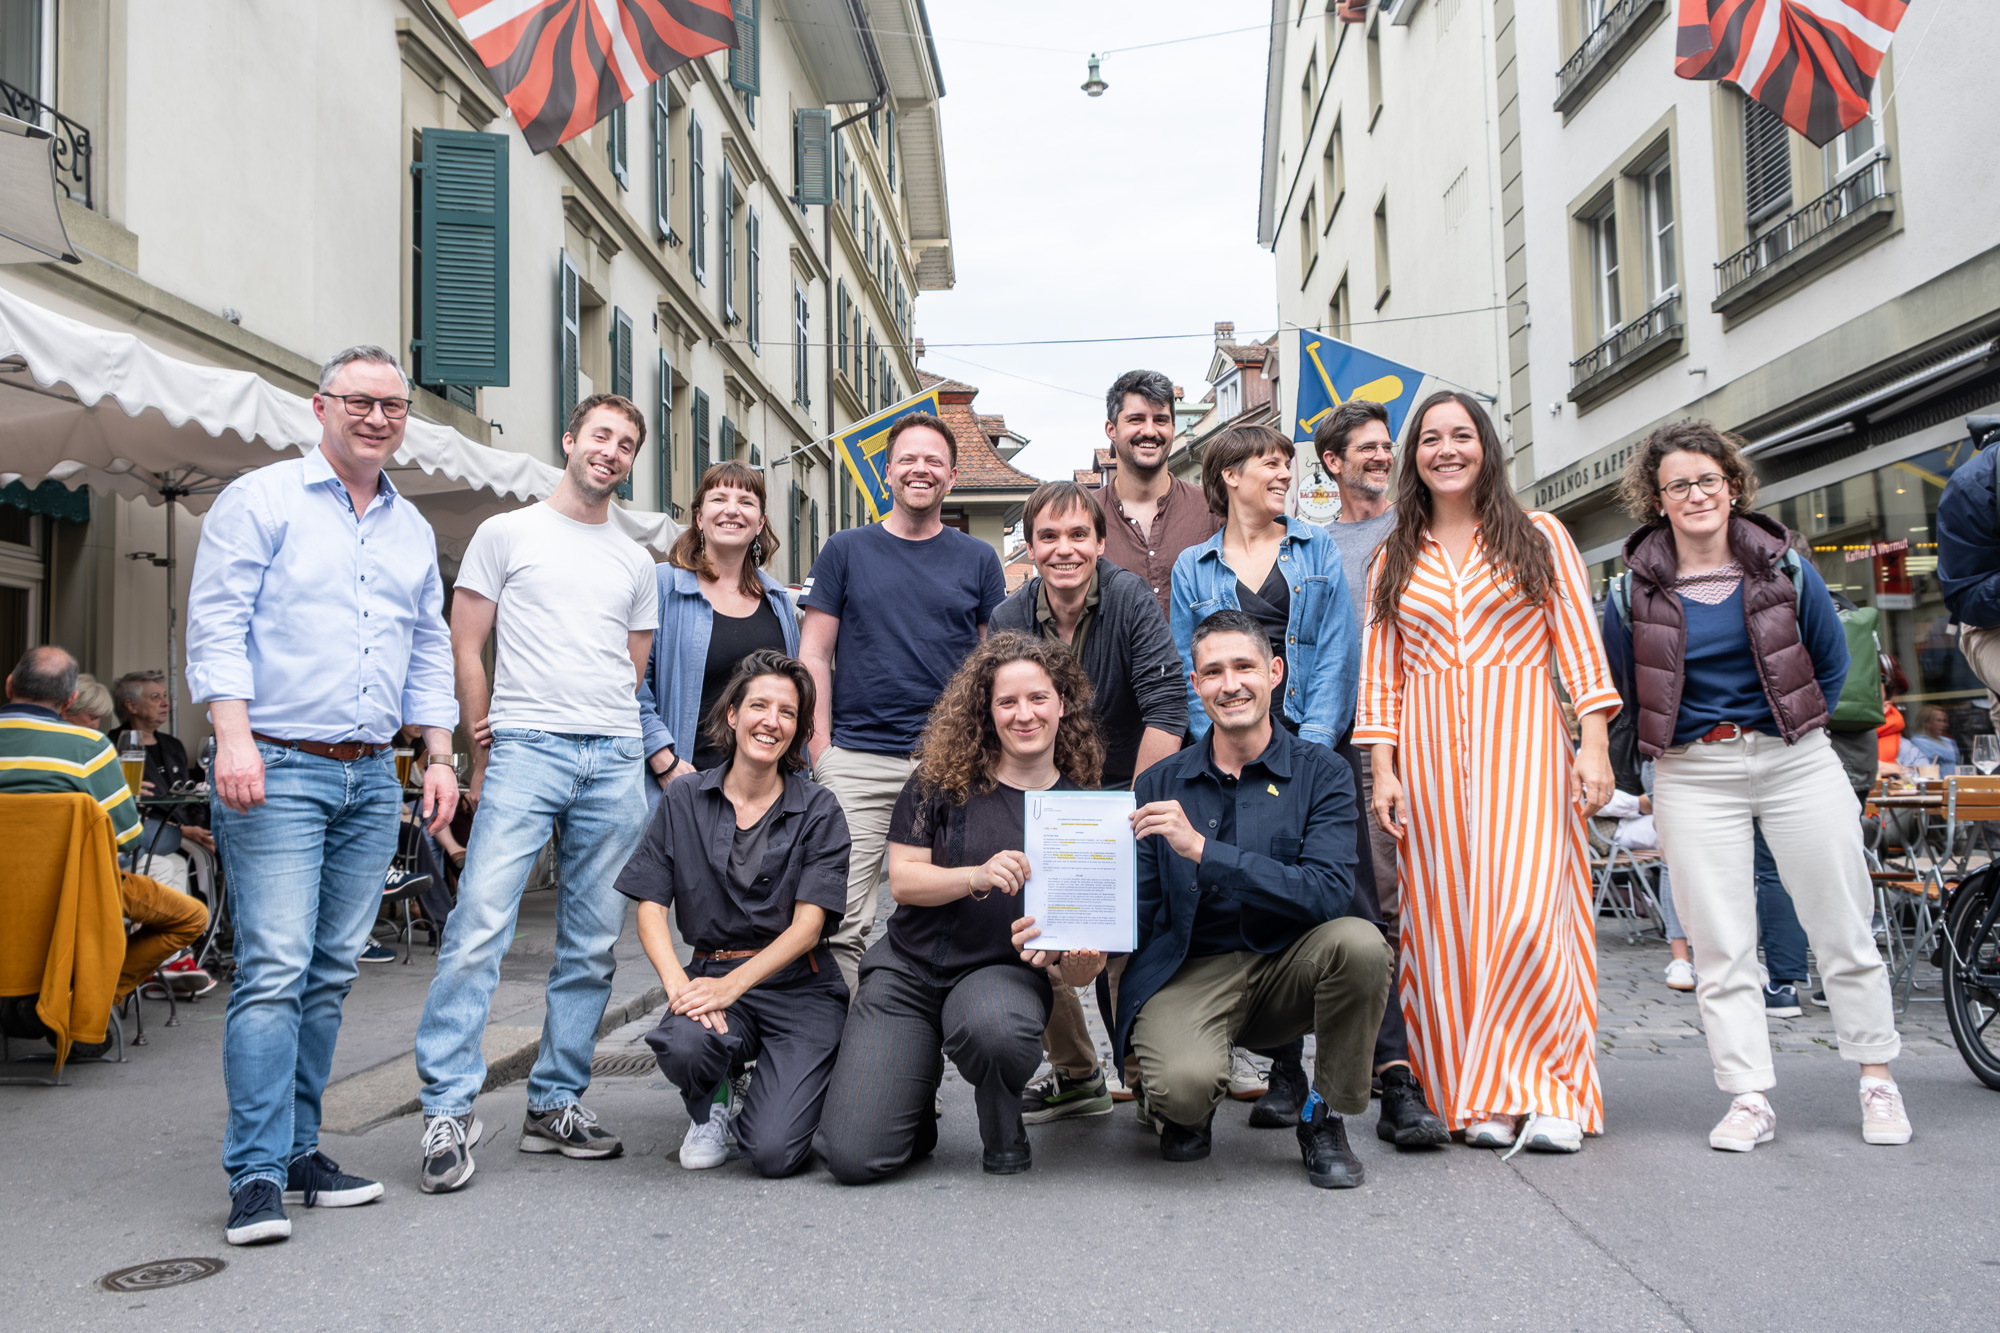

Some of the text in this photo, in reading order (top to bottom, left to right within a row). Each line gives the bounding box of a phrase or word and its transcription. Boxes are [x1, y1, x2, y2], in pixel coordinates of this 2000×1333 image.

[1535, 467, 1588, 508] ADRIANOS
[1845, 537, 1909, 563] Kaffee & Wermut
